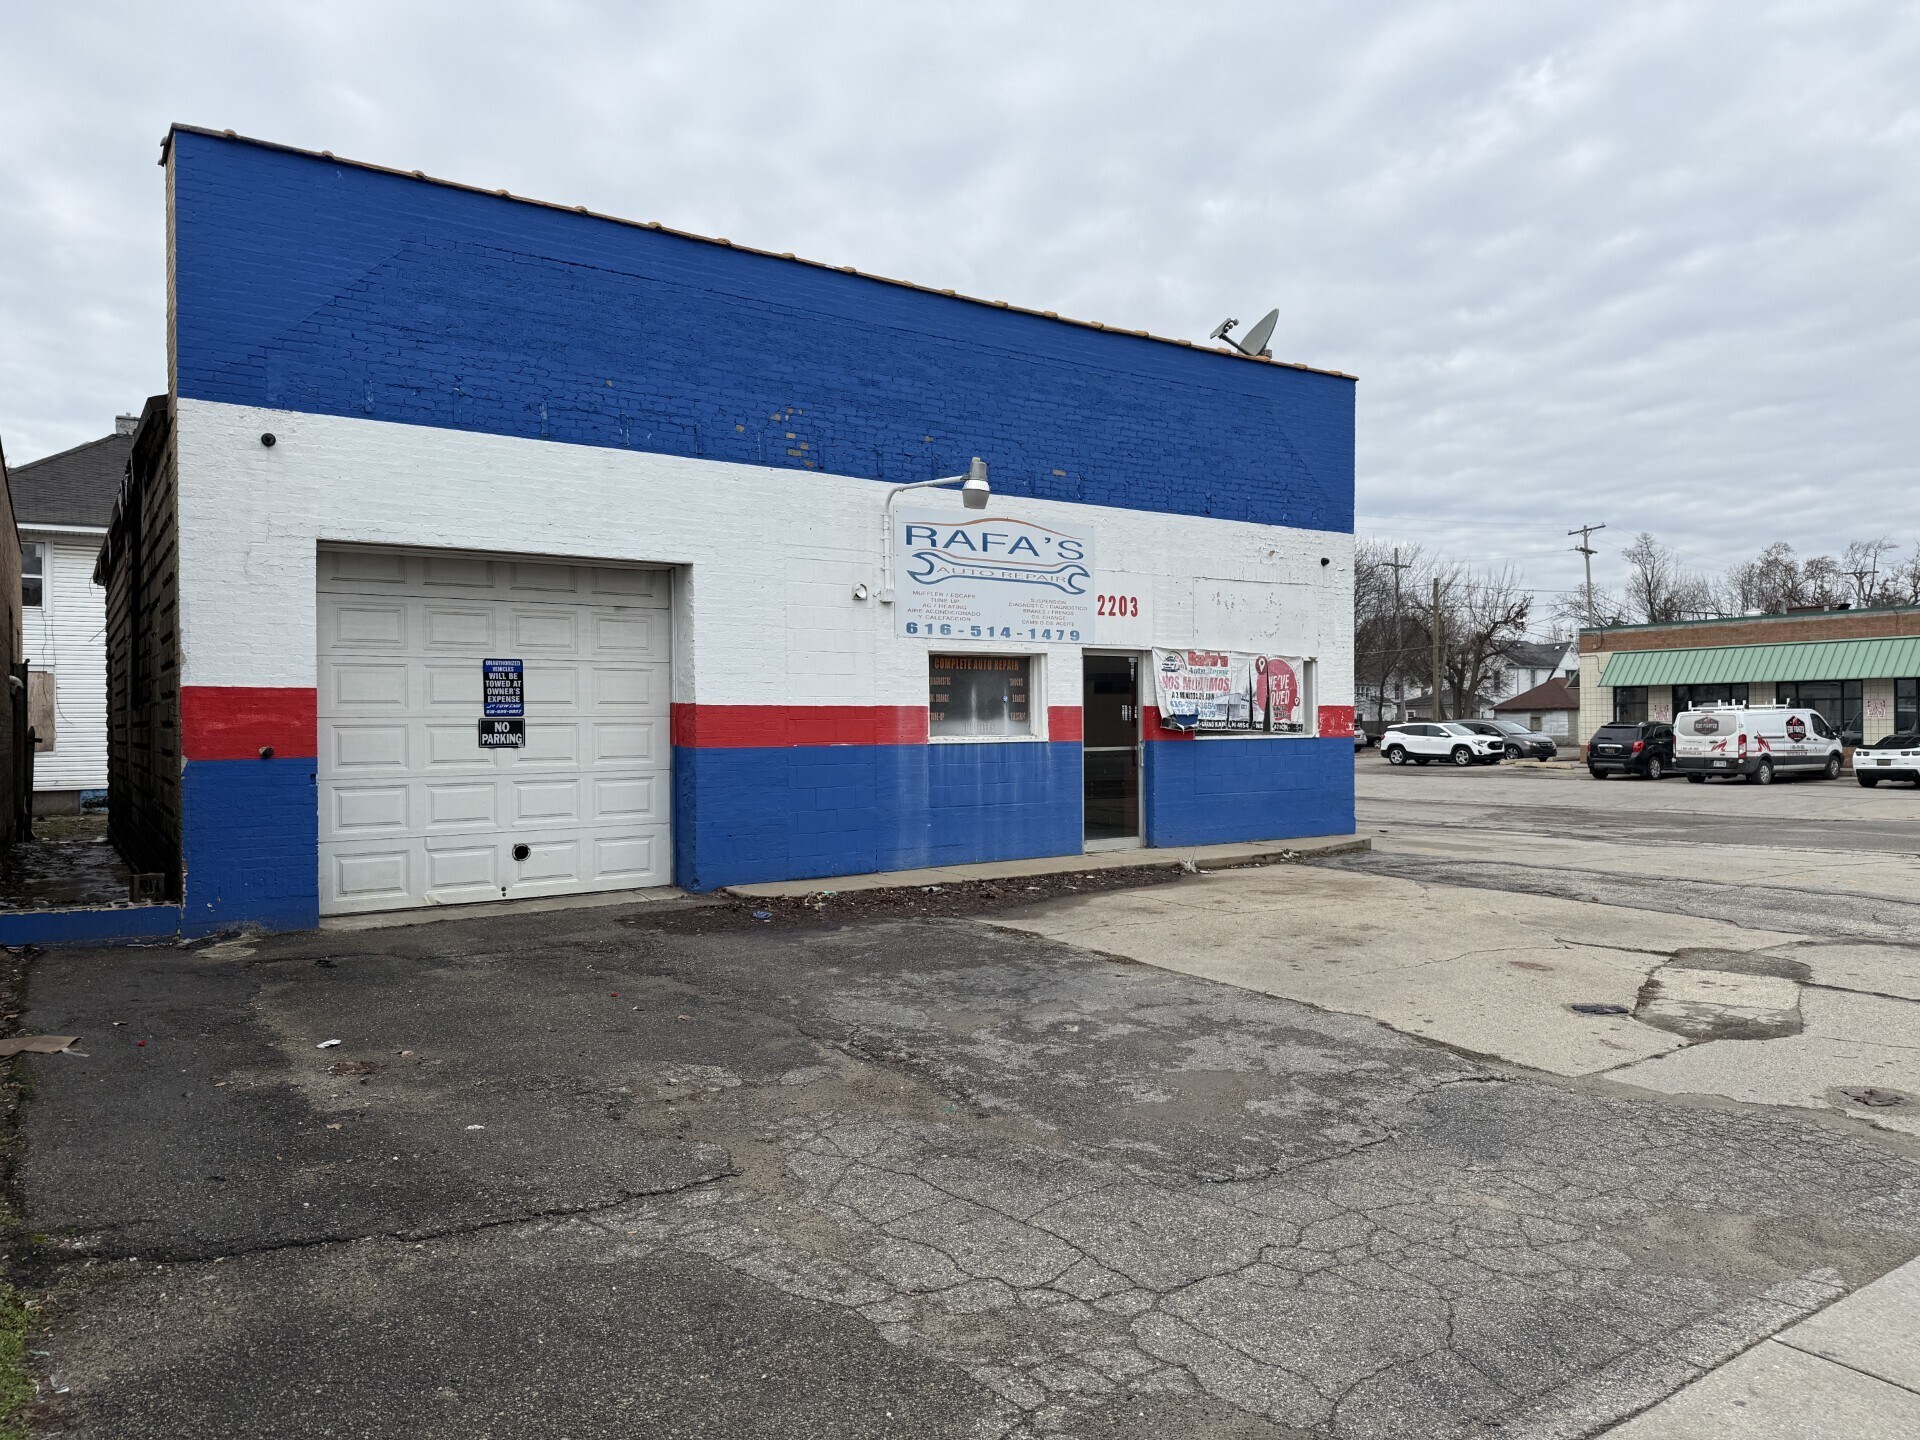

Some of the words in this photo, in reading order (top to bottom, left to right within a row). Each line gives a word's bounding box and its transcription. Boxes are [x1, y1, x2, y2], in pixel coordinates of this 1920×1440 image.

[906, 524, 1084, 560] RAFA'S
[936, 566, 994, 577] AUTO
[1002, 571, 1068, 583] REPAIR
[1097, 594, 1138, 618] 2203
[906, 622, 1080, 641] 616-514-1479
[934, 658, 972, 670] COMPLETE
[973, 659, 992, 670] AUTO
[994, 660, 1019, 670] REPAIR
[1271, 690, 1290, 705] OVED
[494, 722, 510, 732] NO
[482, 734, 522, 744] PARKING
